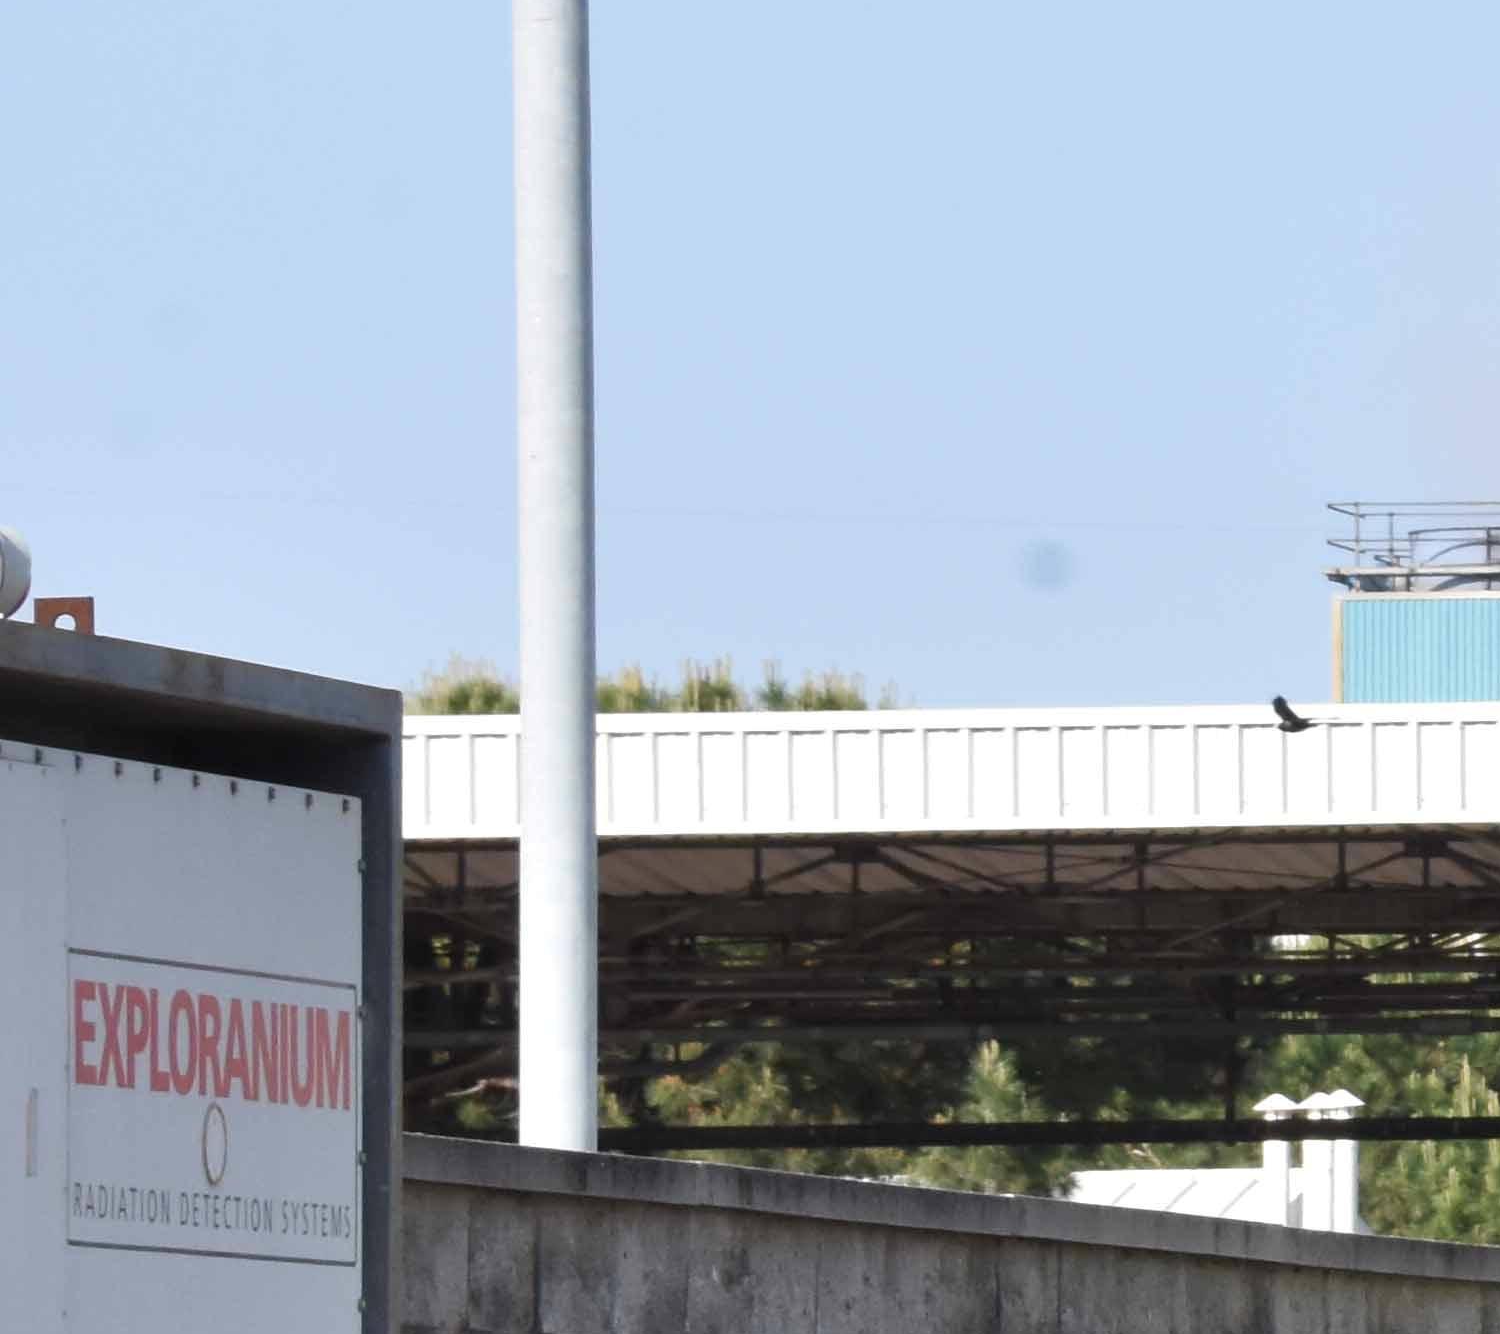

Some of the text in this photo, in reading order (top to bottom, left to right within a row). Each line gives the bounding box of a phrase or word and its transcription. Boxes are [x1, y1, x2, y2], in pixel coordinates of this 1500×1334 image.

[74, 980, 351, 1110] EXPLORANIUM
[73, 1182, 351, 1239] RADIATION DETECTION SYSTEMS
